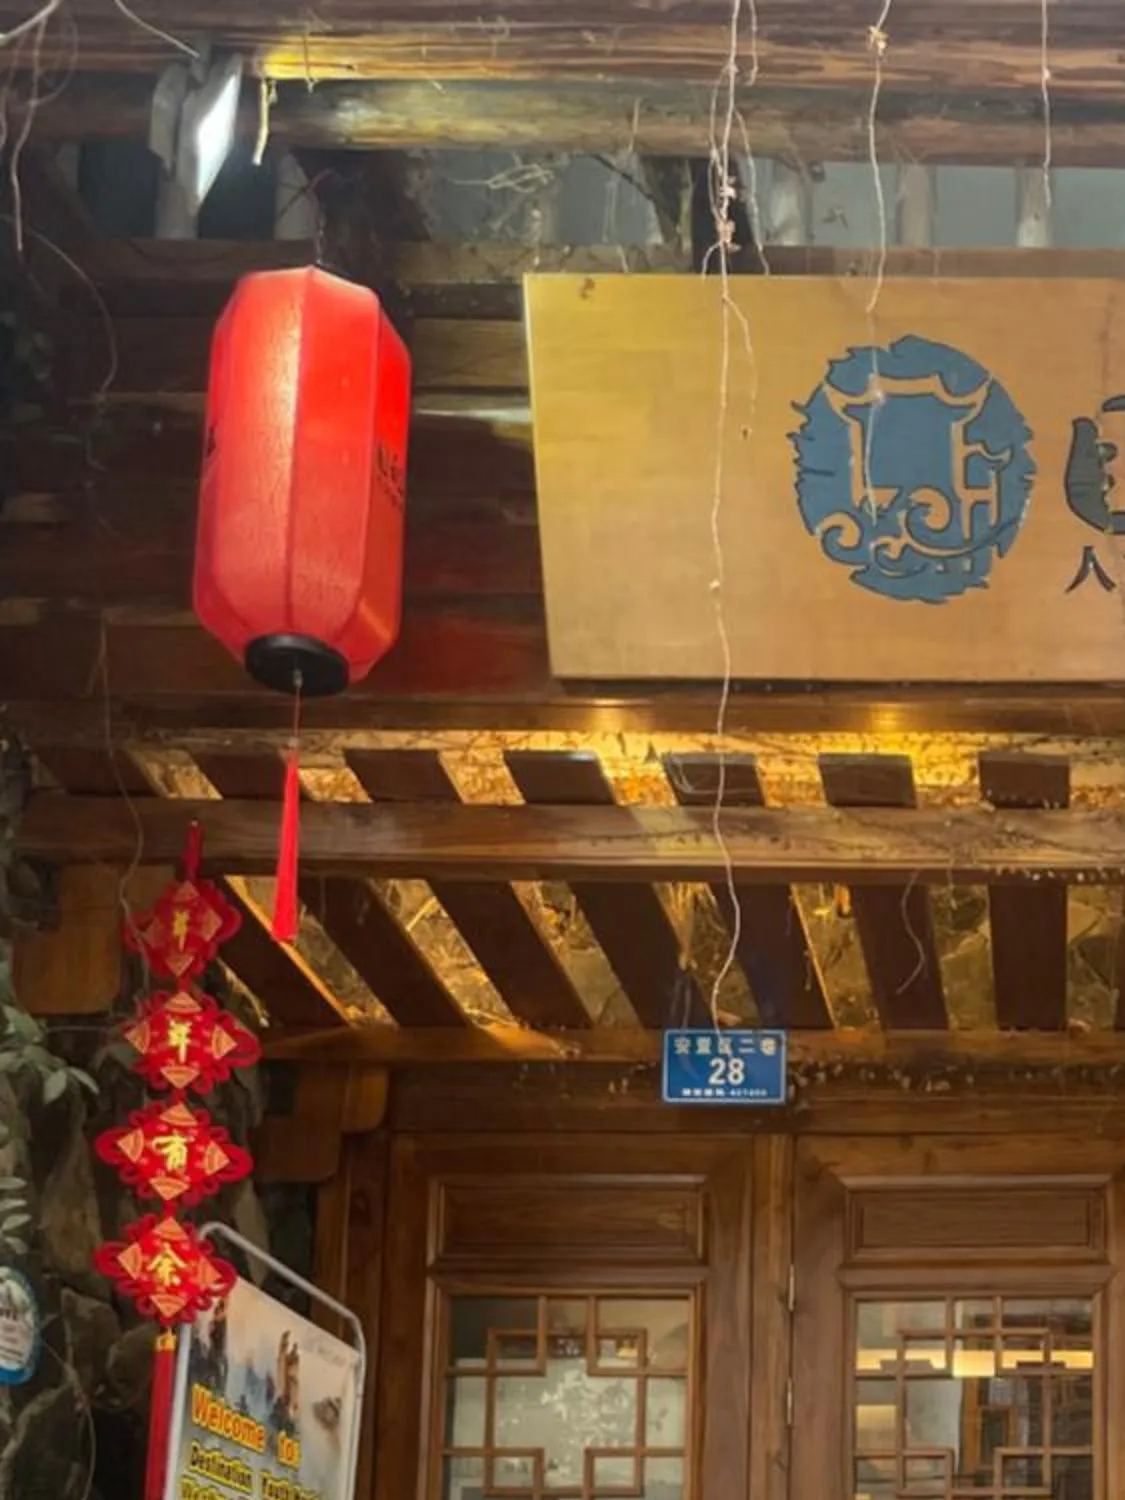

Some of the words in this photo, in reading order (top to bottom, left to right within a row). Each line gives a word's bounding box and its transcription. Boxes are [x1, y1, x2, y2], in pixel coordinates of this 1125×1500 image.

[708, 1057, 745, 1086] 28
[191, 1384, 265, 1453] Welcome
[189, 1441, 253, 1496] Destination
